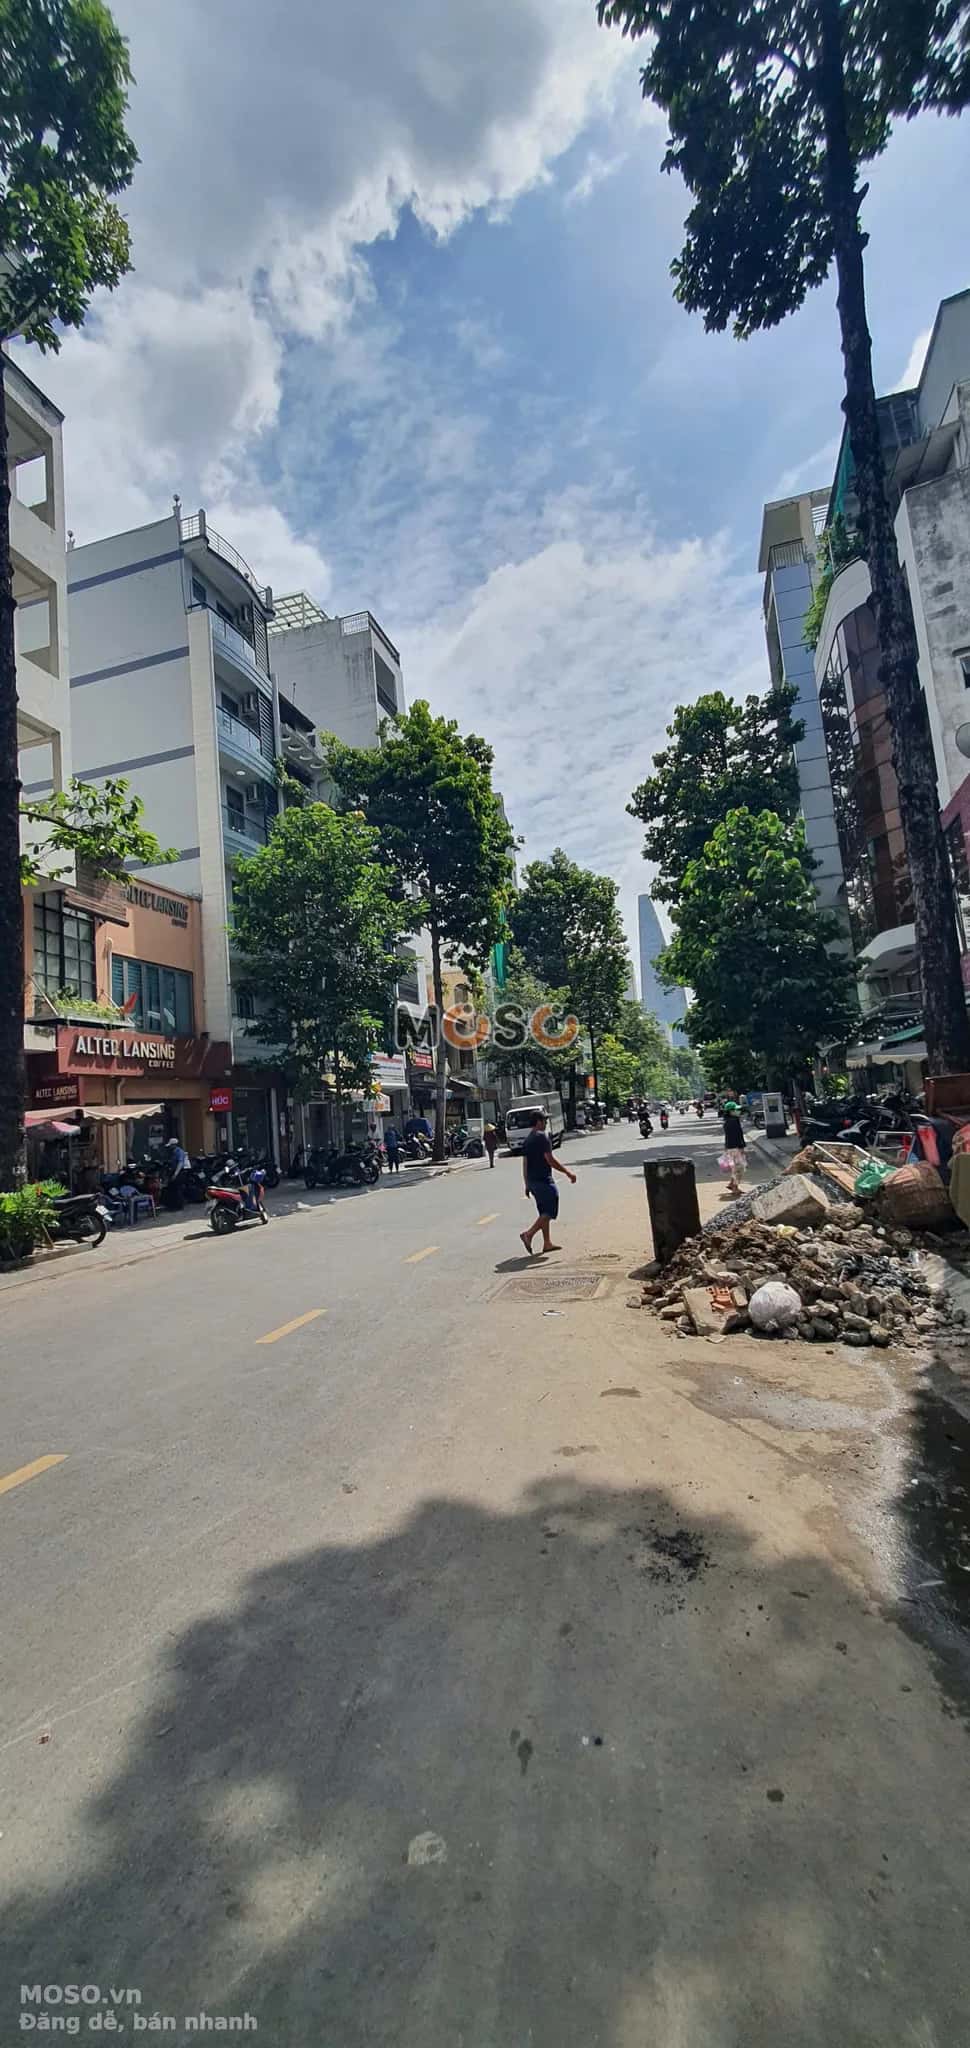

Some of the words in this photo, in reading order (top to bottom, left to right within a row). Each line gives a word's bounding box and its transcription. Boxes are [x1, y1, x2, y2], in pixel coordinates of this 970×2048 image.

[76, 1035, 118, 1056] ALTEC
[123, 1037, 175, 1060] LANSING
[149, 1060, 174, 1069] COFFEE
